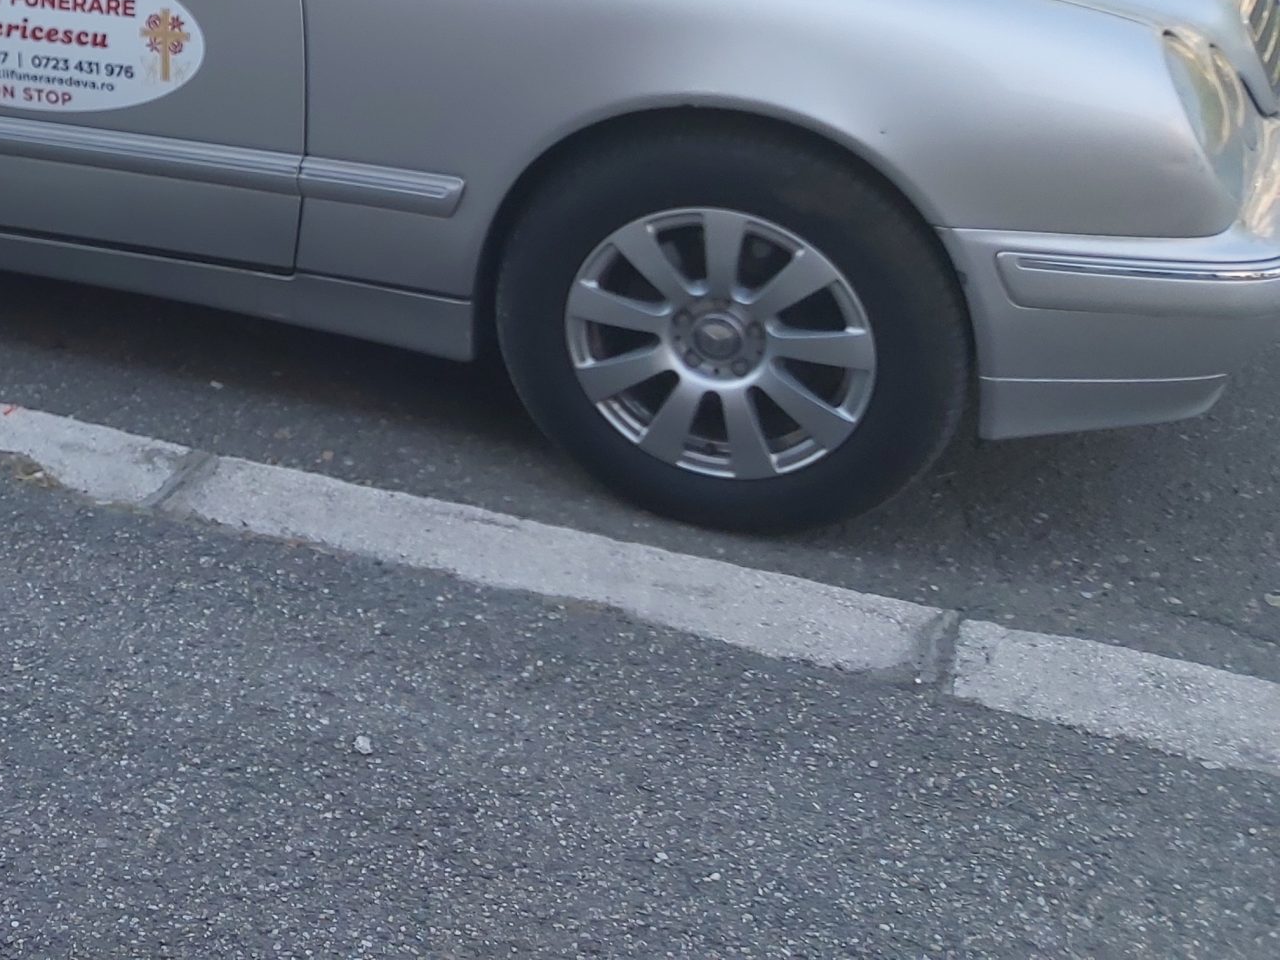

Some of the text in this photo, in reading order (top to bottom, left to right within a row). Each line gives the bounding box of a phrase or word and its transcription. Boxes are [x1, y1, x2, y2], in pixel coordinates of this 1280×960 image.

[31, 55, 69, 72] 0723
[74, 60, 100, 75] 431
[105, 63, 134, 79] 976
[23, 87, 72, 106] STOP
